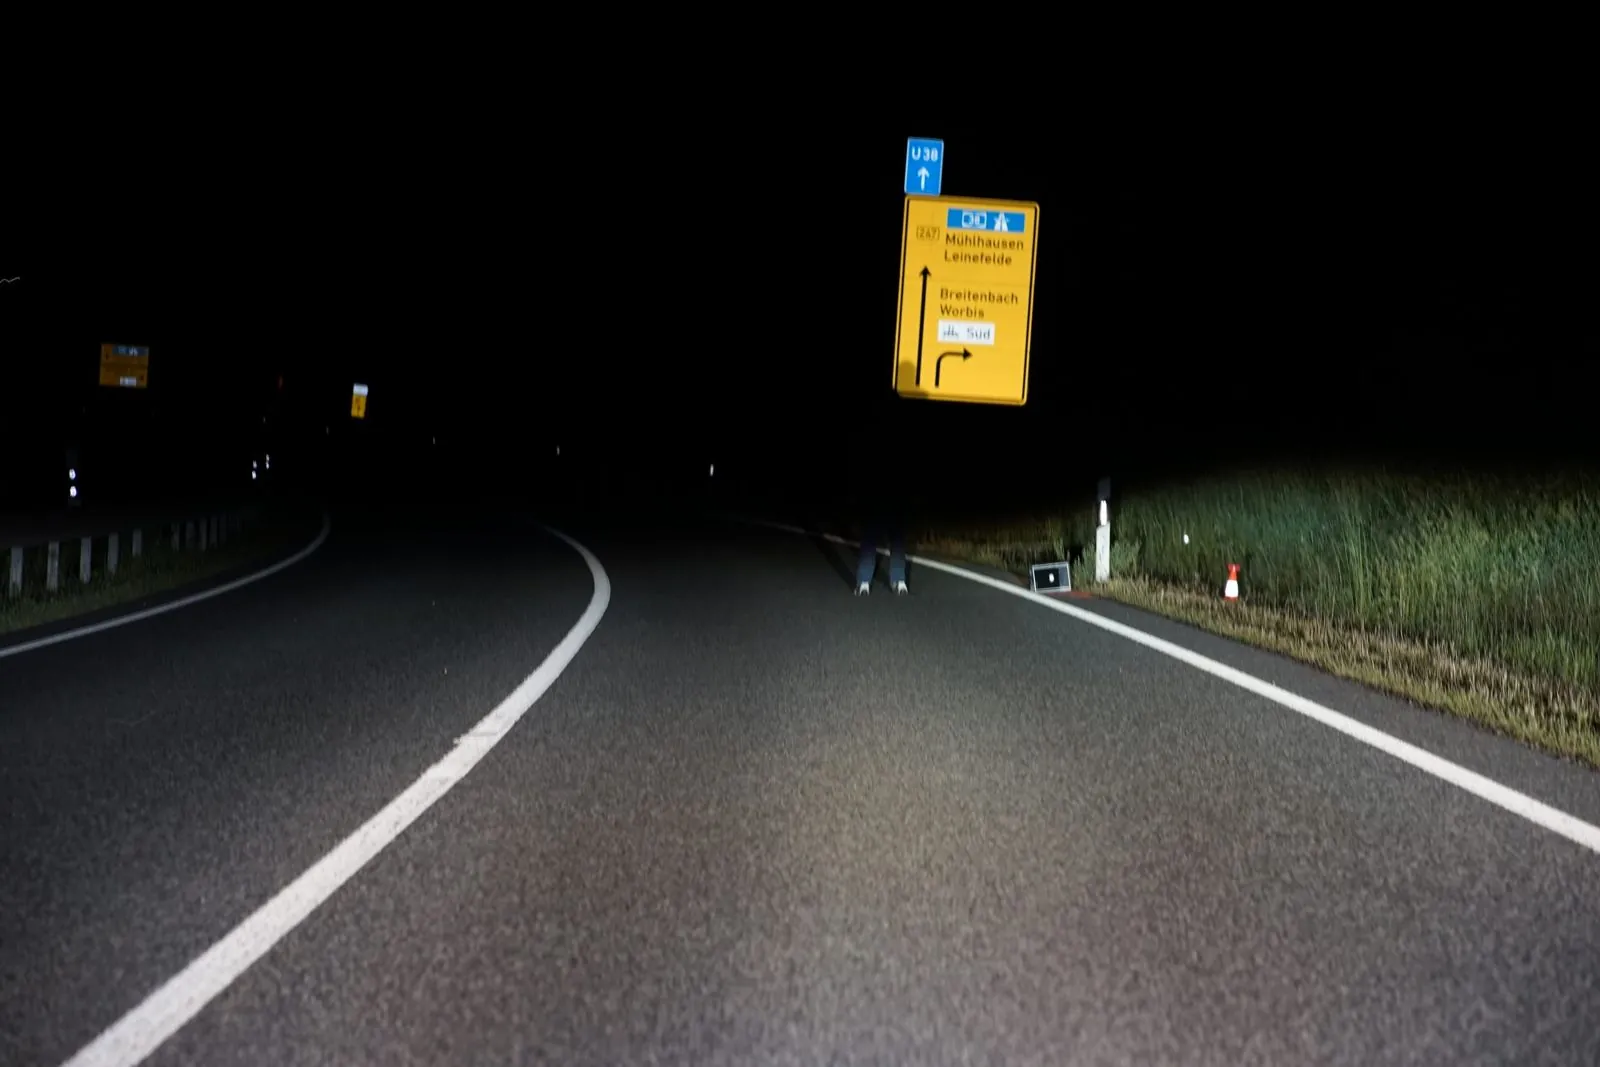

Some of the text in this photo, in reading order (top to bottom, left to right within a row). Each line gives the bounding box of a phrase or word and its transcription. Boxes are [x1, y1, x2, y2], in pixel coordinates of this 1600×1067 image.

[911, 145, 922, 161] U
[945, 232, 1024, 250] Mühlhausen
[944, 249, 1012, 266] Leinefelde
[940, 287, 1019, 305] Breitenbach
[939, 303, 985, 319] Worbis
